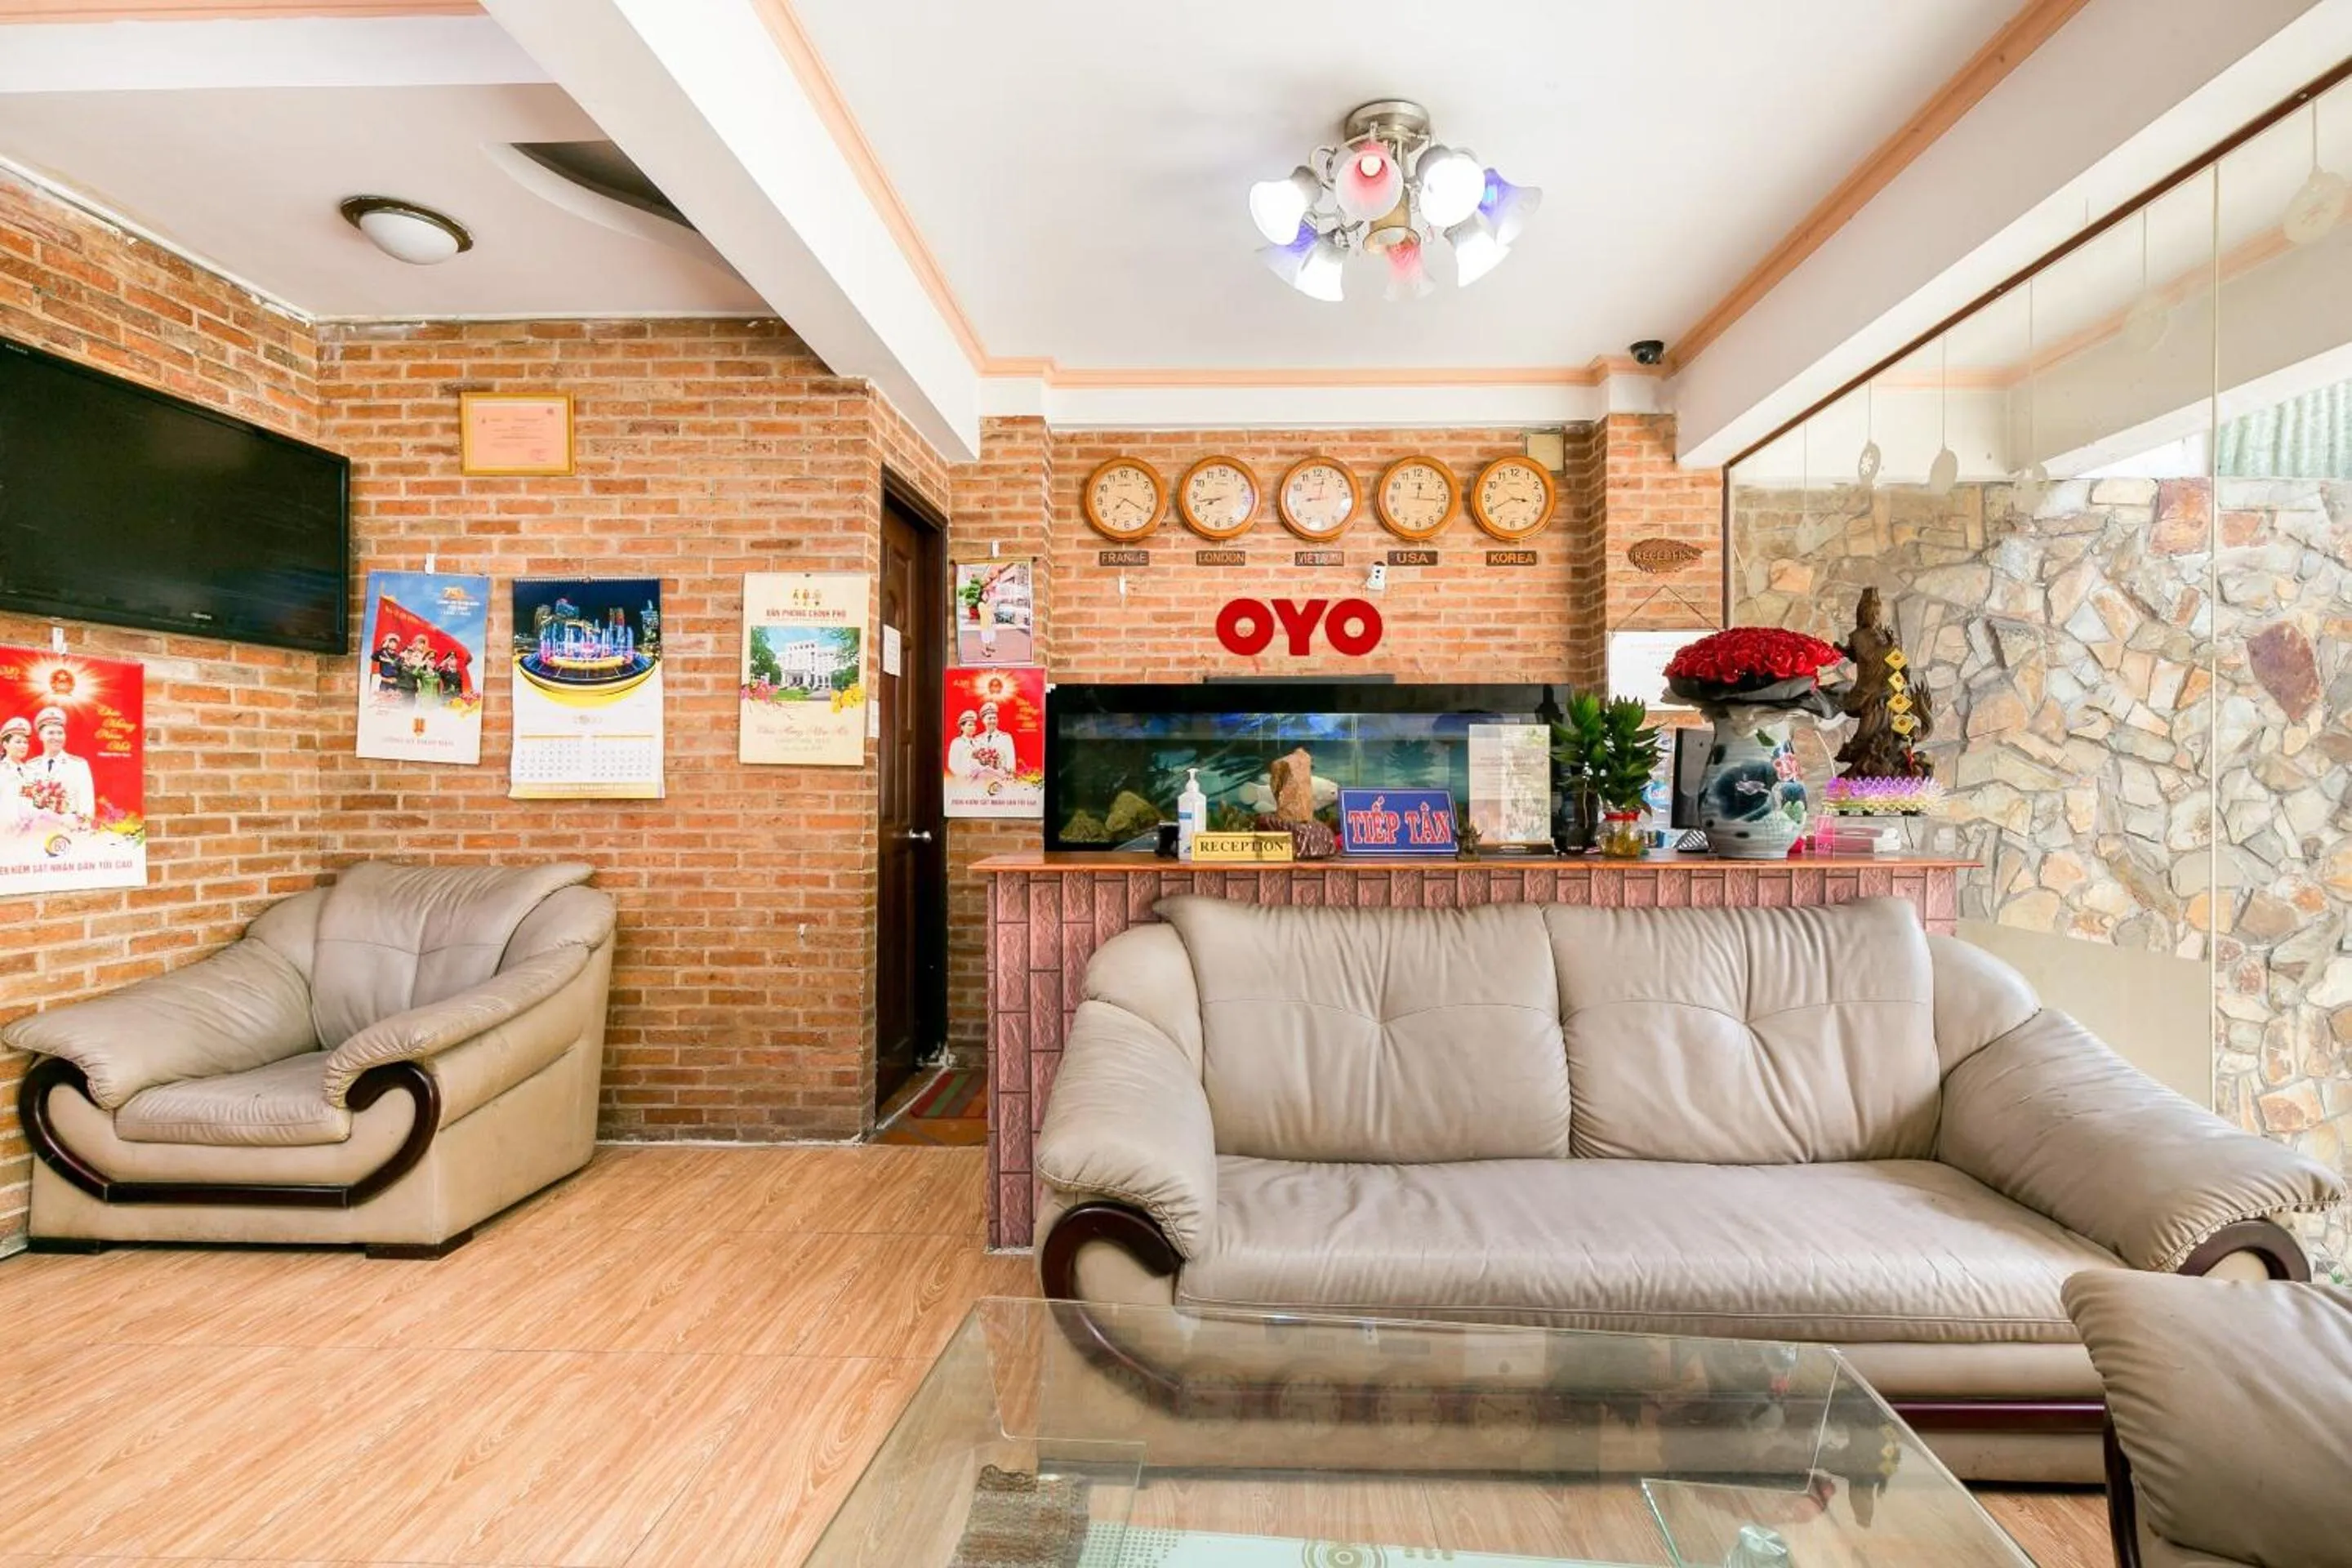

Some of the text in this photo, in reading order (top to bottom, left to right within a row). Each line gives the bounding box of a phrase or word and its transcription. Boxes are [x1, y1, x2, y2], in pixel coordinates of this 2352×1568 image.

[1120, 470, 1129, 479] 12
[1136, 473, 1139, 481] 1
[1218, 468, 1228, 477] 12
[1313, 469, 1323, 477] 12
[1414, 468, 1423, 477] 12
[1499, 472, 1506, 480] 11
[1510, 468, 1519, 477] 12
[1526, 472, 1530, 480] 1
[1108, 474, 1116, 483] 11
[1301, 474, 1308, 482] 11
[1144, 481, 1150, 489] 2
[1195, 479, 1205, 487] 10
[1338, 479, 1343, 488] 2
[1392, 481, 1401, 490] 10
[1437, 481, 1443, 489] 2
[1488, 481, 1497, 490] 10
[1535, 481, 1539, 489] 2
[1099, 483, 1107, 493] 10
[1097, 497, 1103, 506] 9
[1148, 493, 1153, 501] 3
[1441, 493, 1446, 502] 3
[1485, 493, 1490, 502] 9
[1536, 493, 1542, 502] 3
[1194, 505, 1200, 513] 8
[1437, 506, 1443, 514] 4
[1136, 516, 1142, 524] 5
[1415, 520, 1421, 528] 6
[1428, 516, 1433, 524] 5
[1199, 553, 1245, 563] LONDON
[1297, 553, 1342, 564] VIETNM
[1396, 553, 1428, 564] USA
[1490, 553, 1534, 564] KOREA
[1216, 599, 1383, 656] OYO
[1348, 793, 1452, 844] TIẾP TÂN
[1200, 840, 1285, 853] RECEPTION
